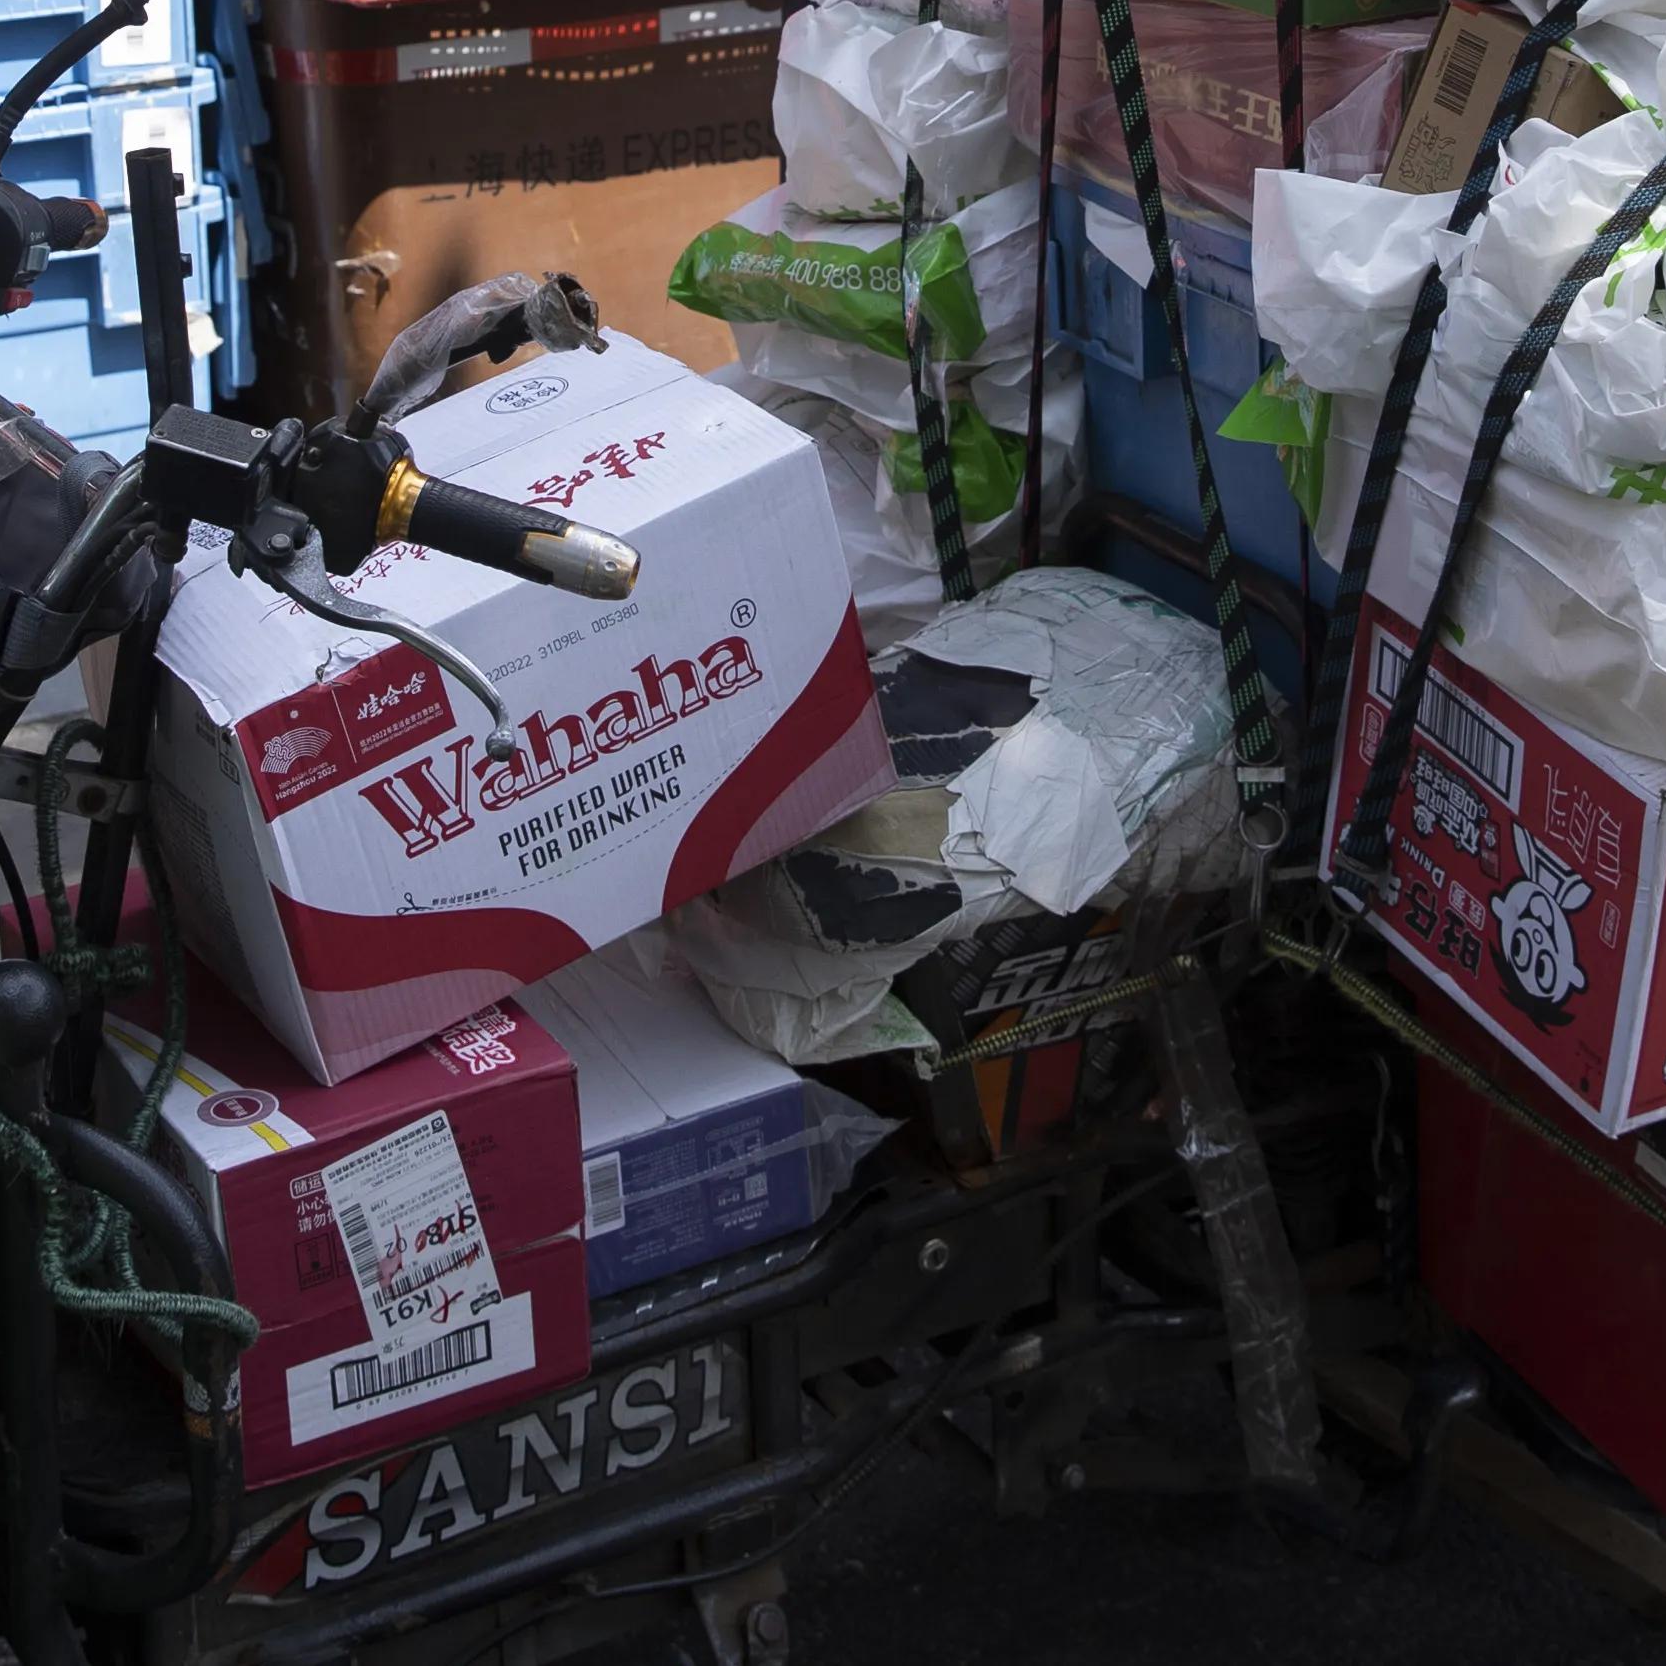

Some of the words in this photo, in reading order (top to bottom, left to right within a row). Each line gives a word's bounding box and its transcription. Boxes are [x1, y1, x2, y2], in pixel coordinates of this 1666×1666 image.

[418, 134, 609, 203] 上海快递
[784, 257, 820, 287] 400
[356, 672, 426, 721] 娃哈哈
[358, 634, 764, 860] Wahaha
[275, 775, 316, 801] Hangzhou
[317, 764, 338, 782] 2022
[498, 783, 605, 858] PURIFIED
[612, 743, 687, 799] WATER
[518, 840, 563, 879] FOR
[569, 776, 683, 852] DRINKING
[1400, 837, 1446, 890] DRINK
[1401, 880, 1485, 980] 旺仔
[379, 1288, 433, 1329] K91
[304, 1341, 741, 1591] SANSI
